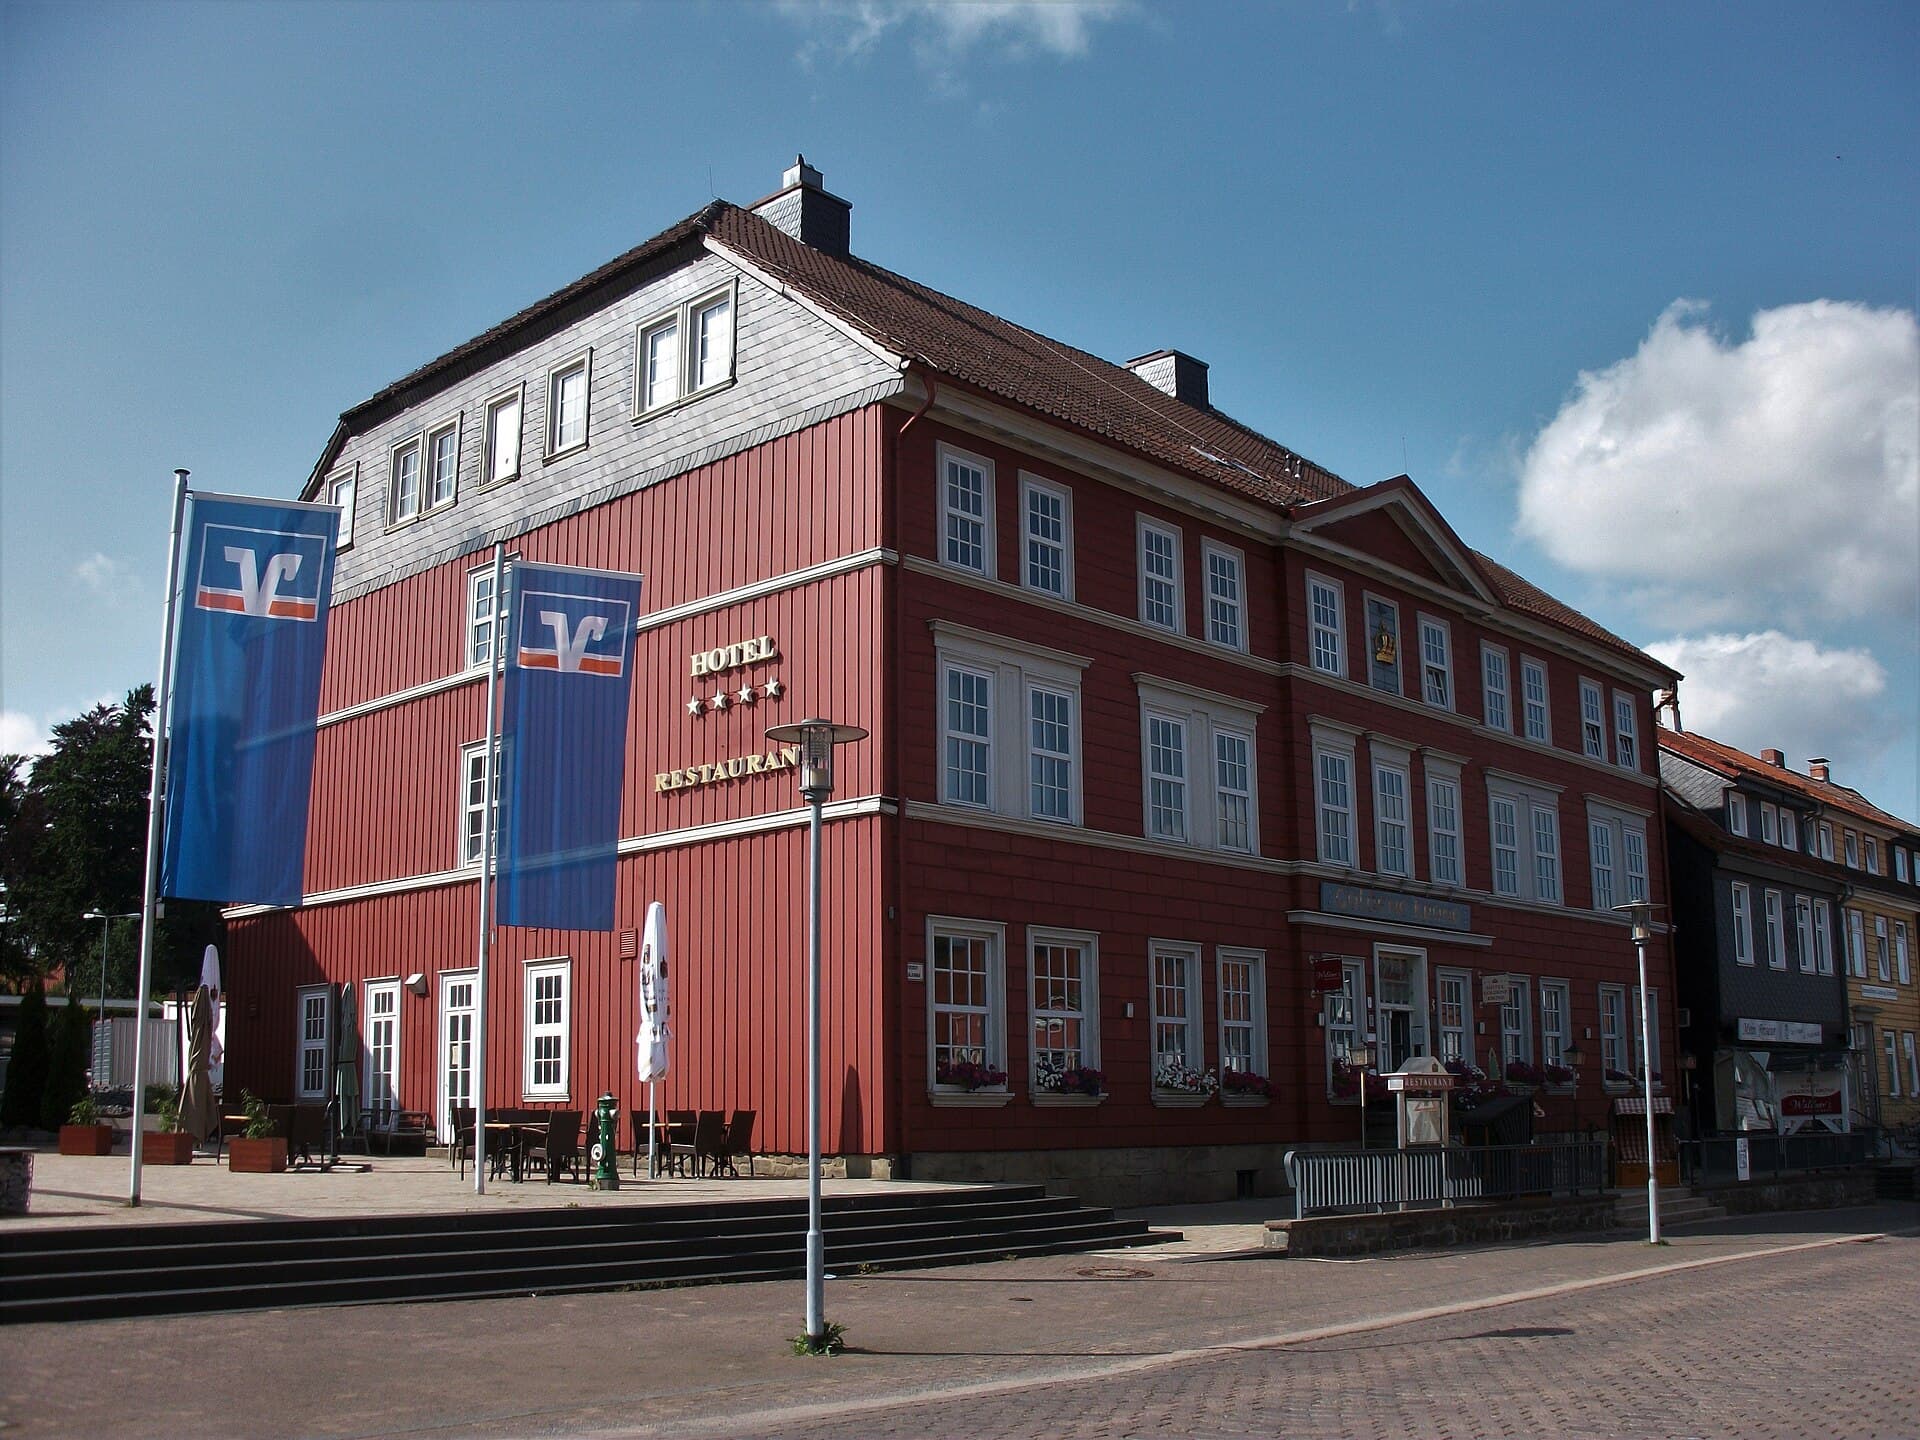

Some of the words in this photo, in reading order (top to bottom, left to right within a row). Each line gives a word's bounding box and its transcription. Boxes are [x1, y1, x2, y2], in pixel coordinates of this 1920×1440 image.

[690, 636, 777, 677] HOTEL
[655, 746, 801, 792] RESTAURAN
[1404, 1077, 1453, 1088] RESTAURANT
